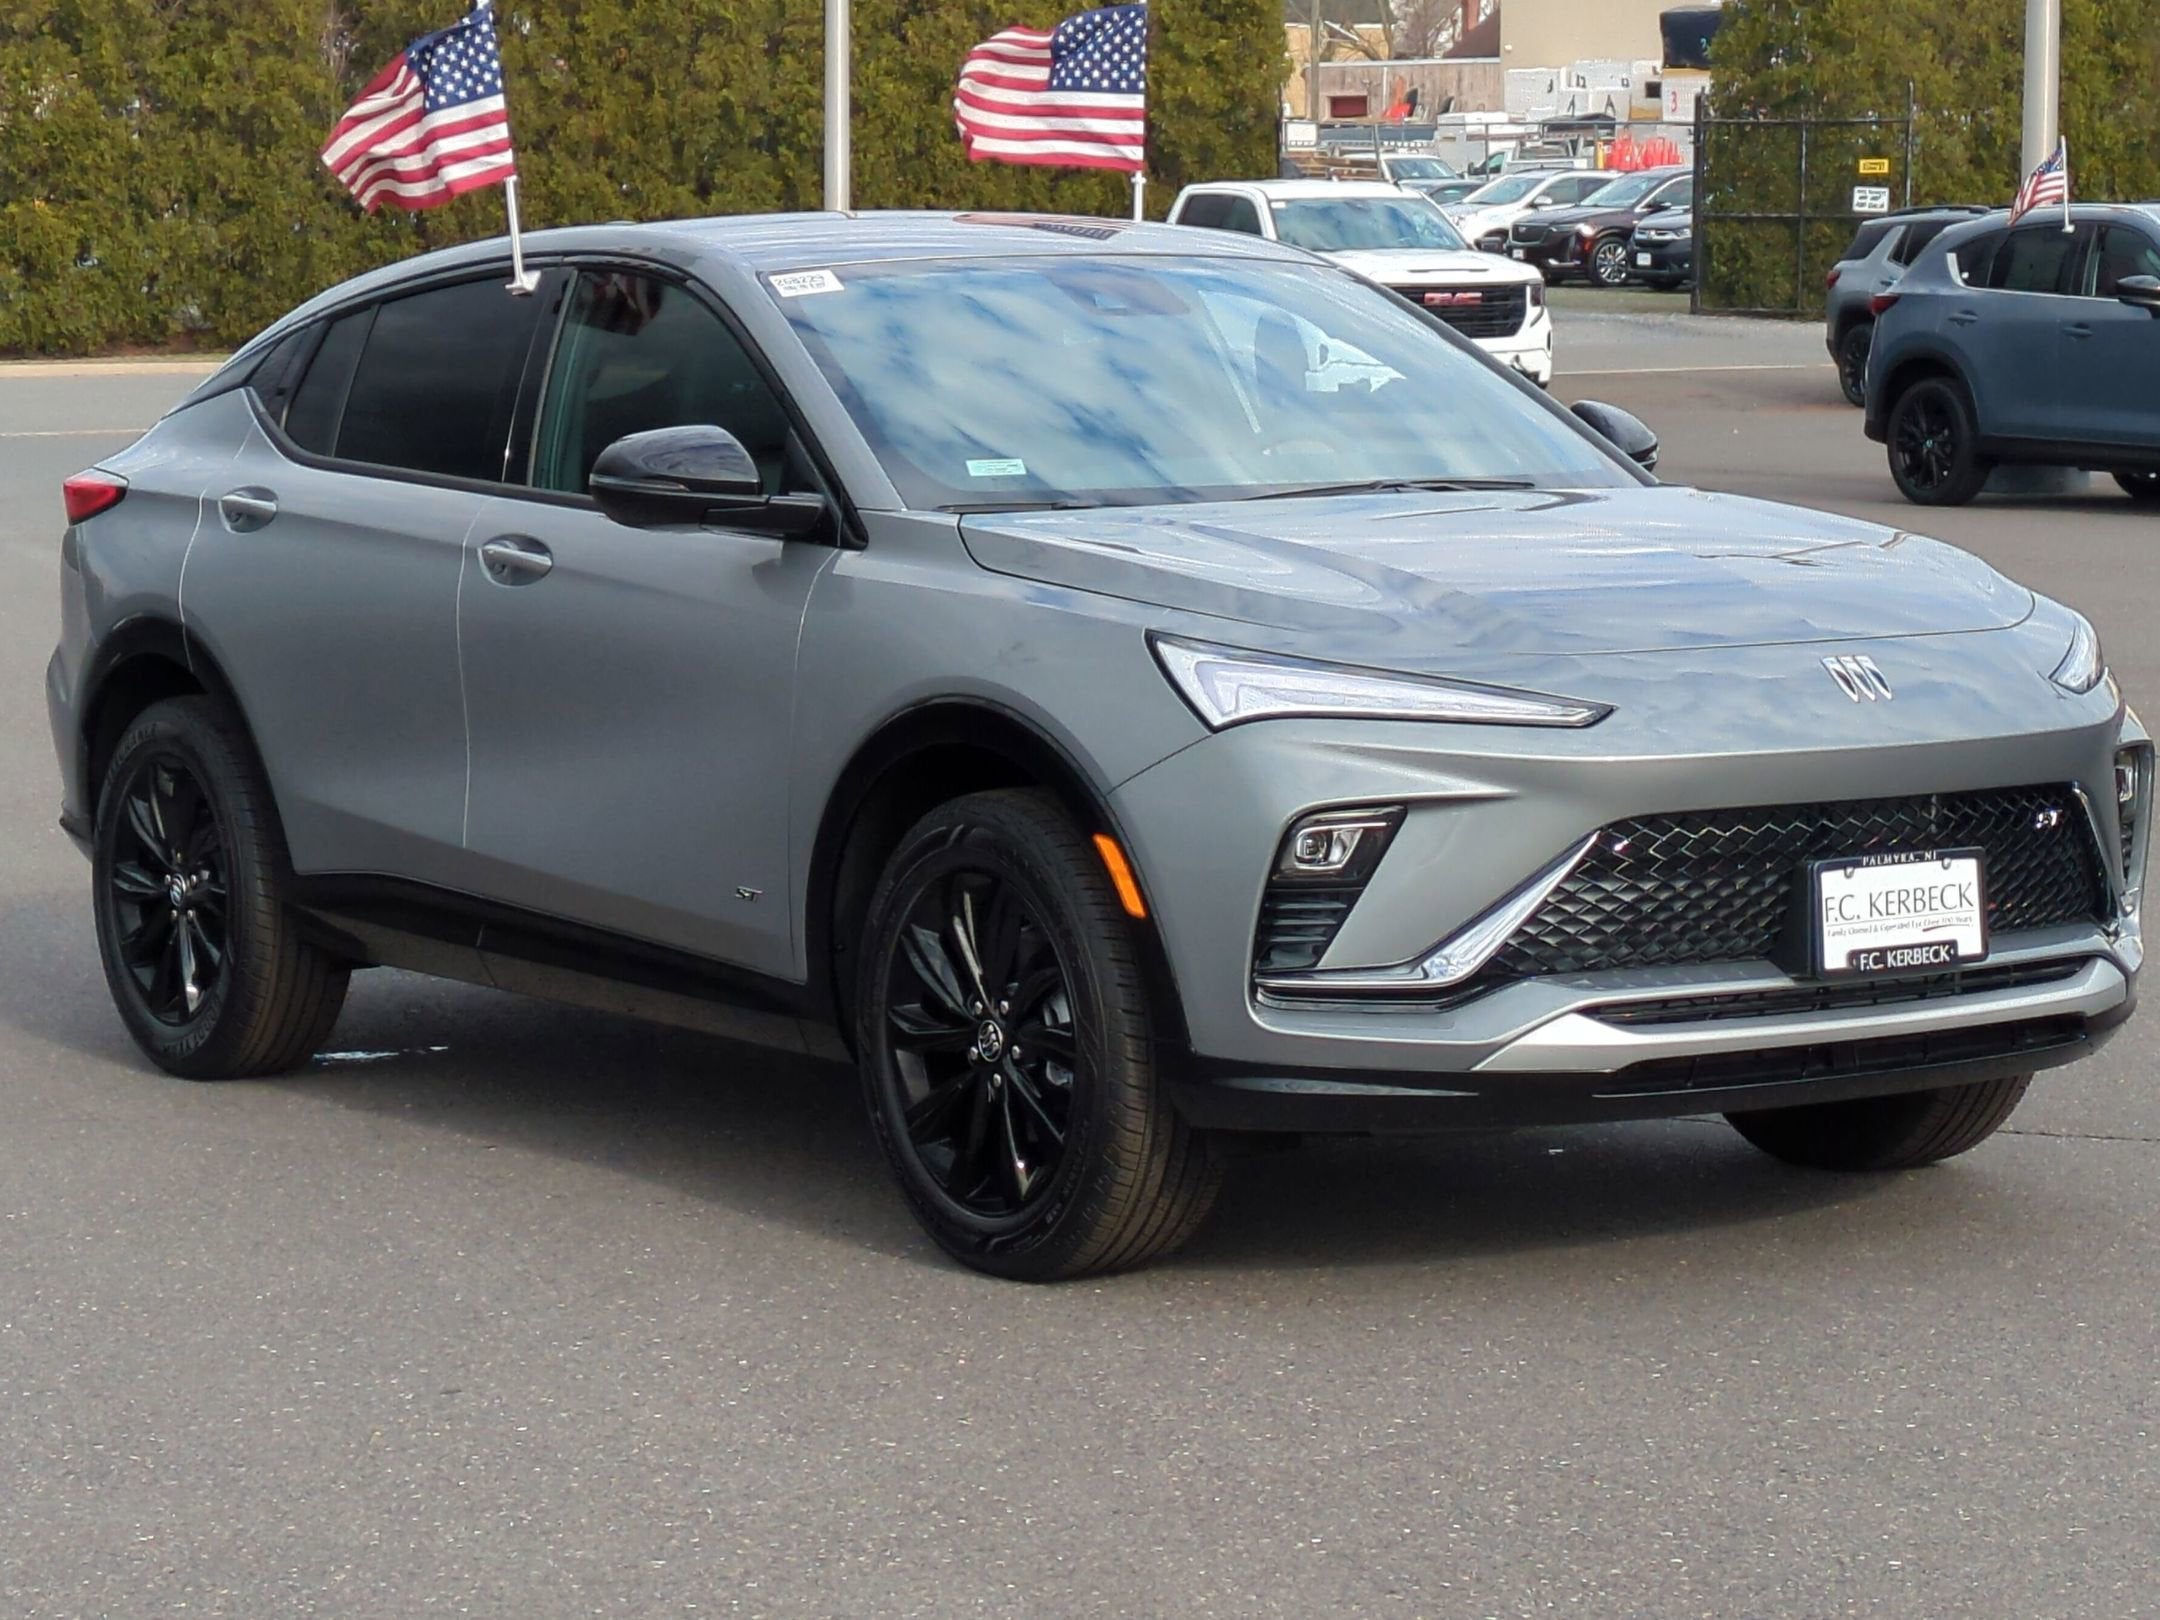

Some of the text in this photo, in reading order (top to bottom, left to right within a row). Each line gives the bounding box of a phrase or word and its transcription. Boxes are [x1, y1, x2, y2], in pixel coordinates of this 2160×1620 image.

[1824, 882, 1974, 923] F.C. KERBECK
[1860, 944, 1950, 971] F.C. KERBECK
